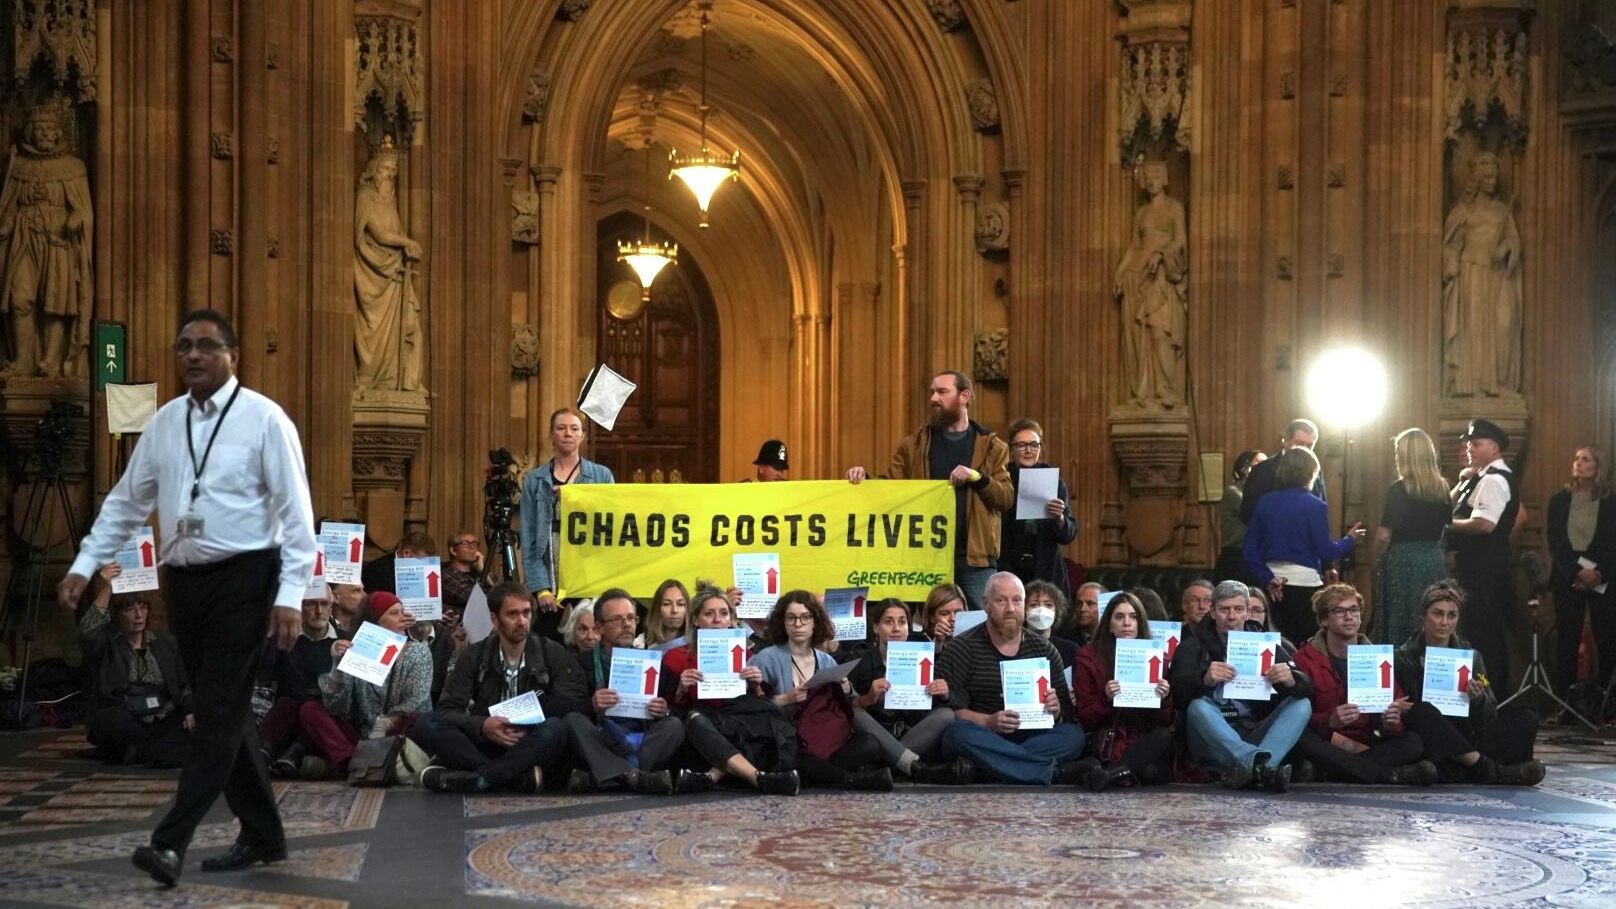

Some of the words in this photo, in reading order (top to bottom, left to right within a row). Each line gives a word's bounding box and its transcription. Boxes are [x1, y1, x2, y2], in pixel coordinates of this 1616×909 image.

[567, 511, 690, 548] CHAOS
[710, 513, 826, 547] COSTS
[847, 513, 948, 549] LIVES
[847, 570, 946, 586] GREENPEACE
